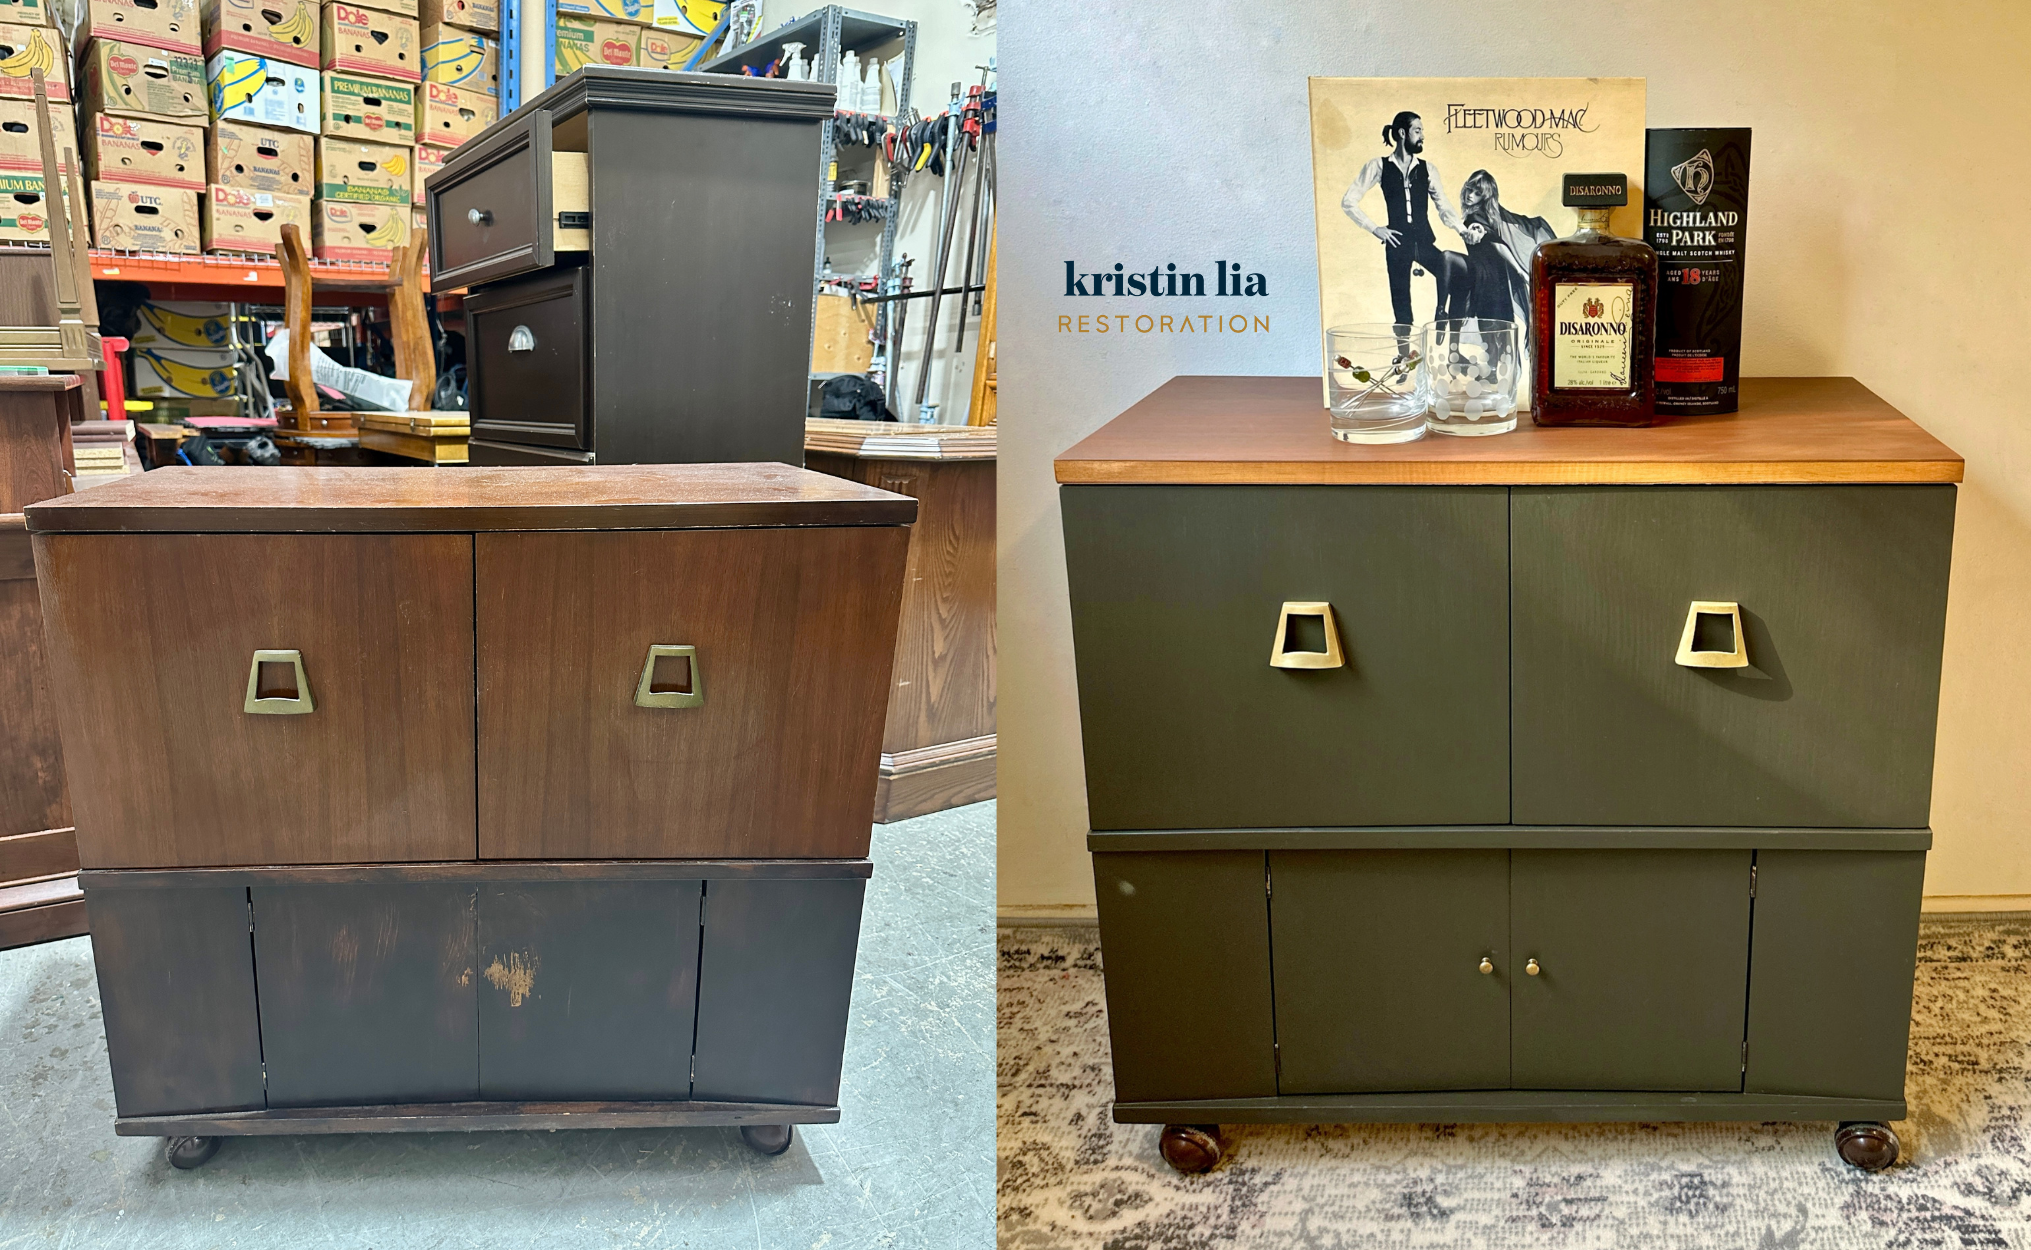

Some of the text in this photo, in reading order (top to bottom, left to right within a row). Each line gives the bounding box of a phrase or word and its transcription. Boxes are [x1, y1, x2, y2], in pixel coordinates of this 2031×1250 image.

[336, 5, 369, 26] Dole
[338, 27, 371, 39] BANANAS
[556, 29, 584, 40] emium
[560, 40, 590, 53] NANAS
[1443, 103, 1545, 134] FLEETWOOD
[101, 139, 140, 151] BANANAS
[261, 138, 279, 149] UTC
[1494, 132, 1563, 159] RUMOURS
[1569, 185, 1622, 196] DISARONNO
[1649, 208, 1738, 227] HIGHLAND
[1671, 229, 1717, 246] PARK
[1681, 267, 1701, 285] 18
[1560, 321, 1626, 337] DISARONNO
